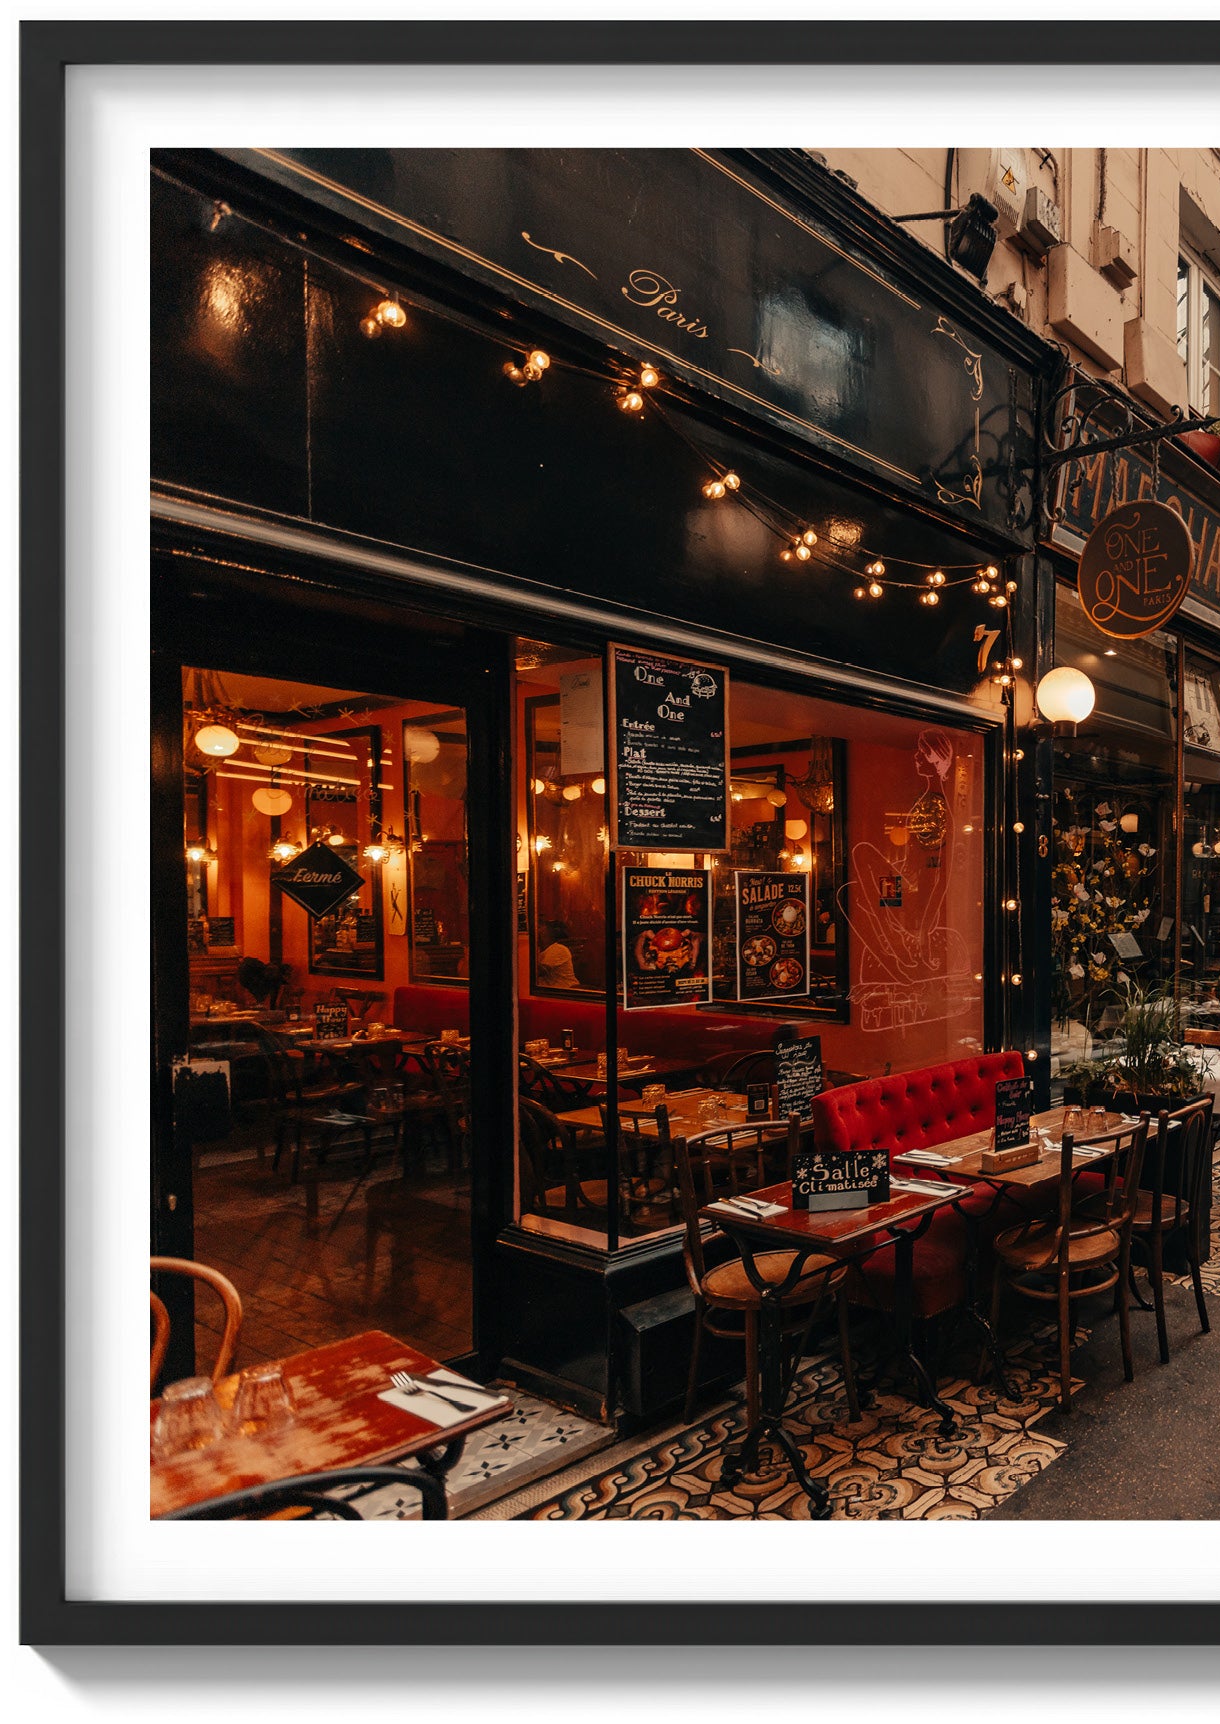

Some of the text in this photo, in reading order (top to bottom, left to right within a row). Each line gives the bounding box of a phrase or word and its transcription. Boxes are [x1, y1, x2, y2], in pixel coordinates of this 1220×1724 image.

[621, 269, 709, 338] Paris
[1104, 513, 1160, 560] ONE
[1114, 561, 1134, 573] AND
[1092, 553, 1173, 616] ONE
[1143, 594, 1171, 606] PARIS
[973, 624, 1001, 673] 7
[634, 666, 665, 686] One
[665, 692, 691, 706] And
[657, 704, 685, 720] One
[622, 718, 655, 732] Entrée
[623, 746, 647, 760] Plat
[624, 806, 667, 818] Dessert
[1038, 834, 1048, 858] 8
[291, 867, 343, 884] Fermé
[629, 875, 704, 888] CHUCK NORRIS
[742, 883, 785, 906] SALADE
[811, 1160, 869, 1181] Salle
